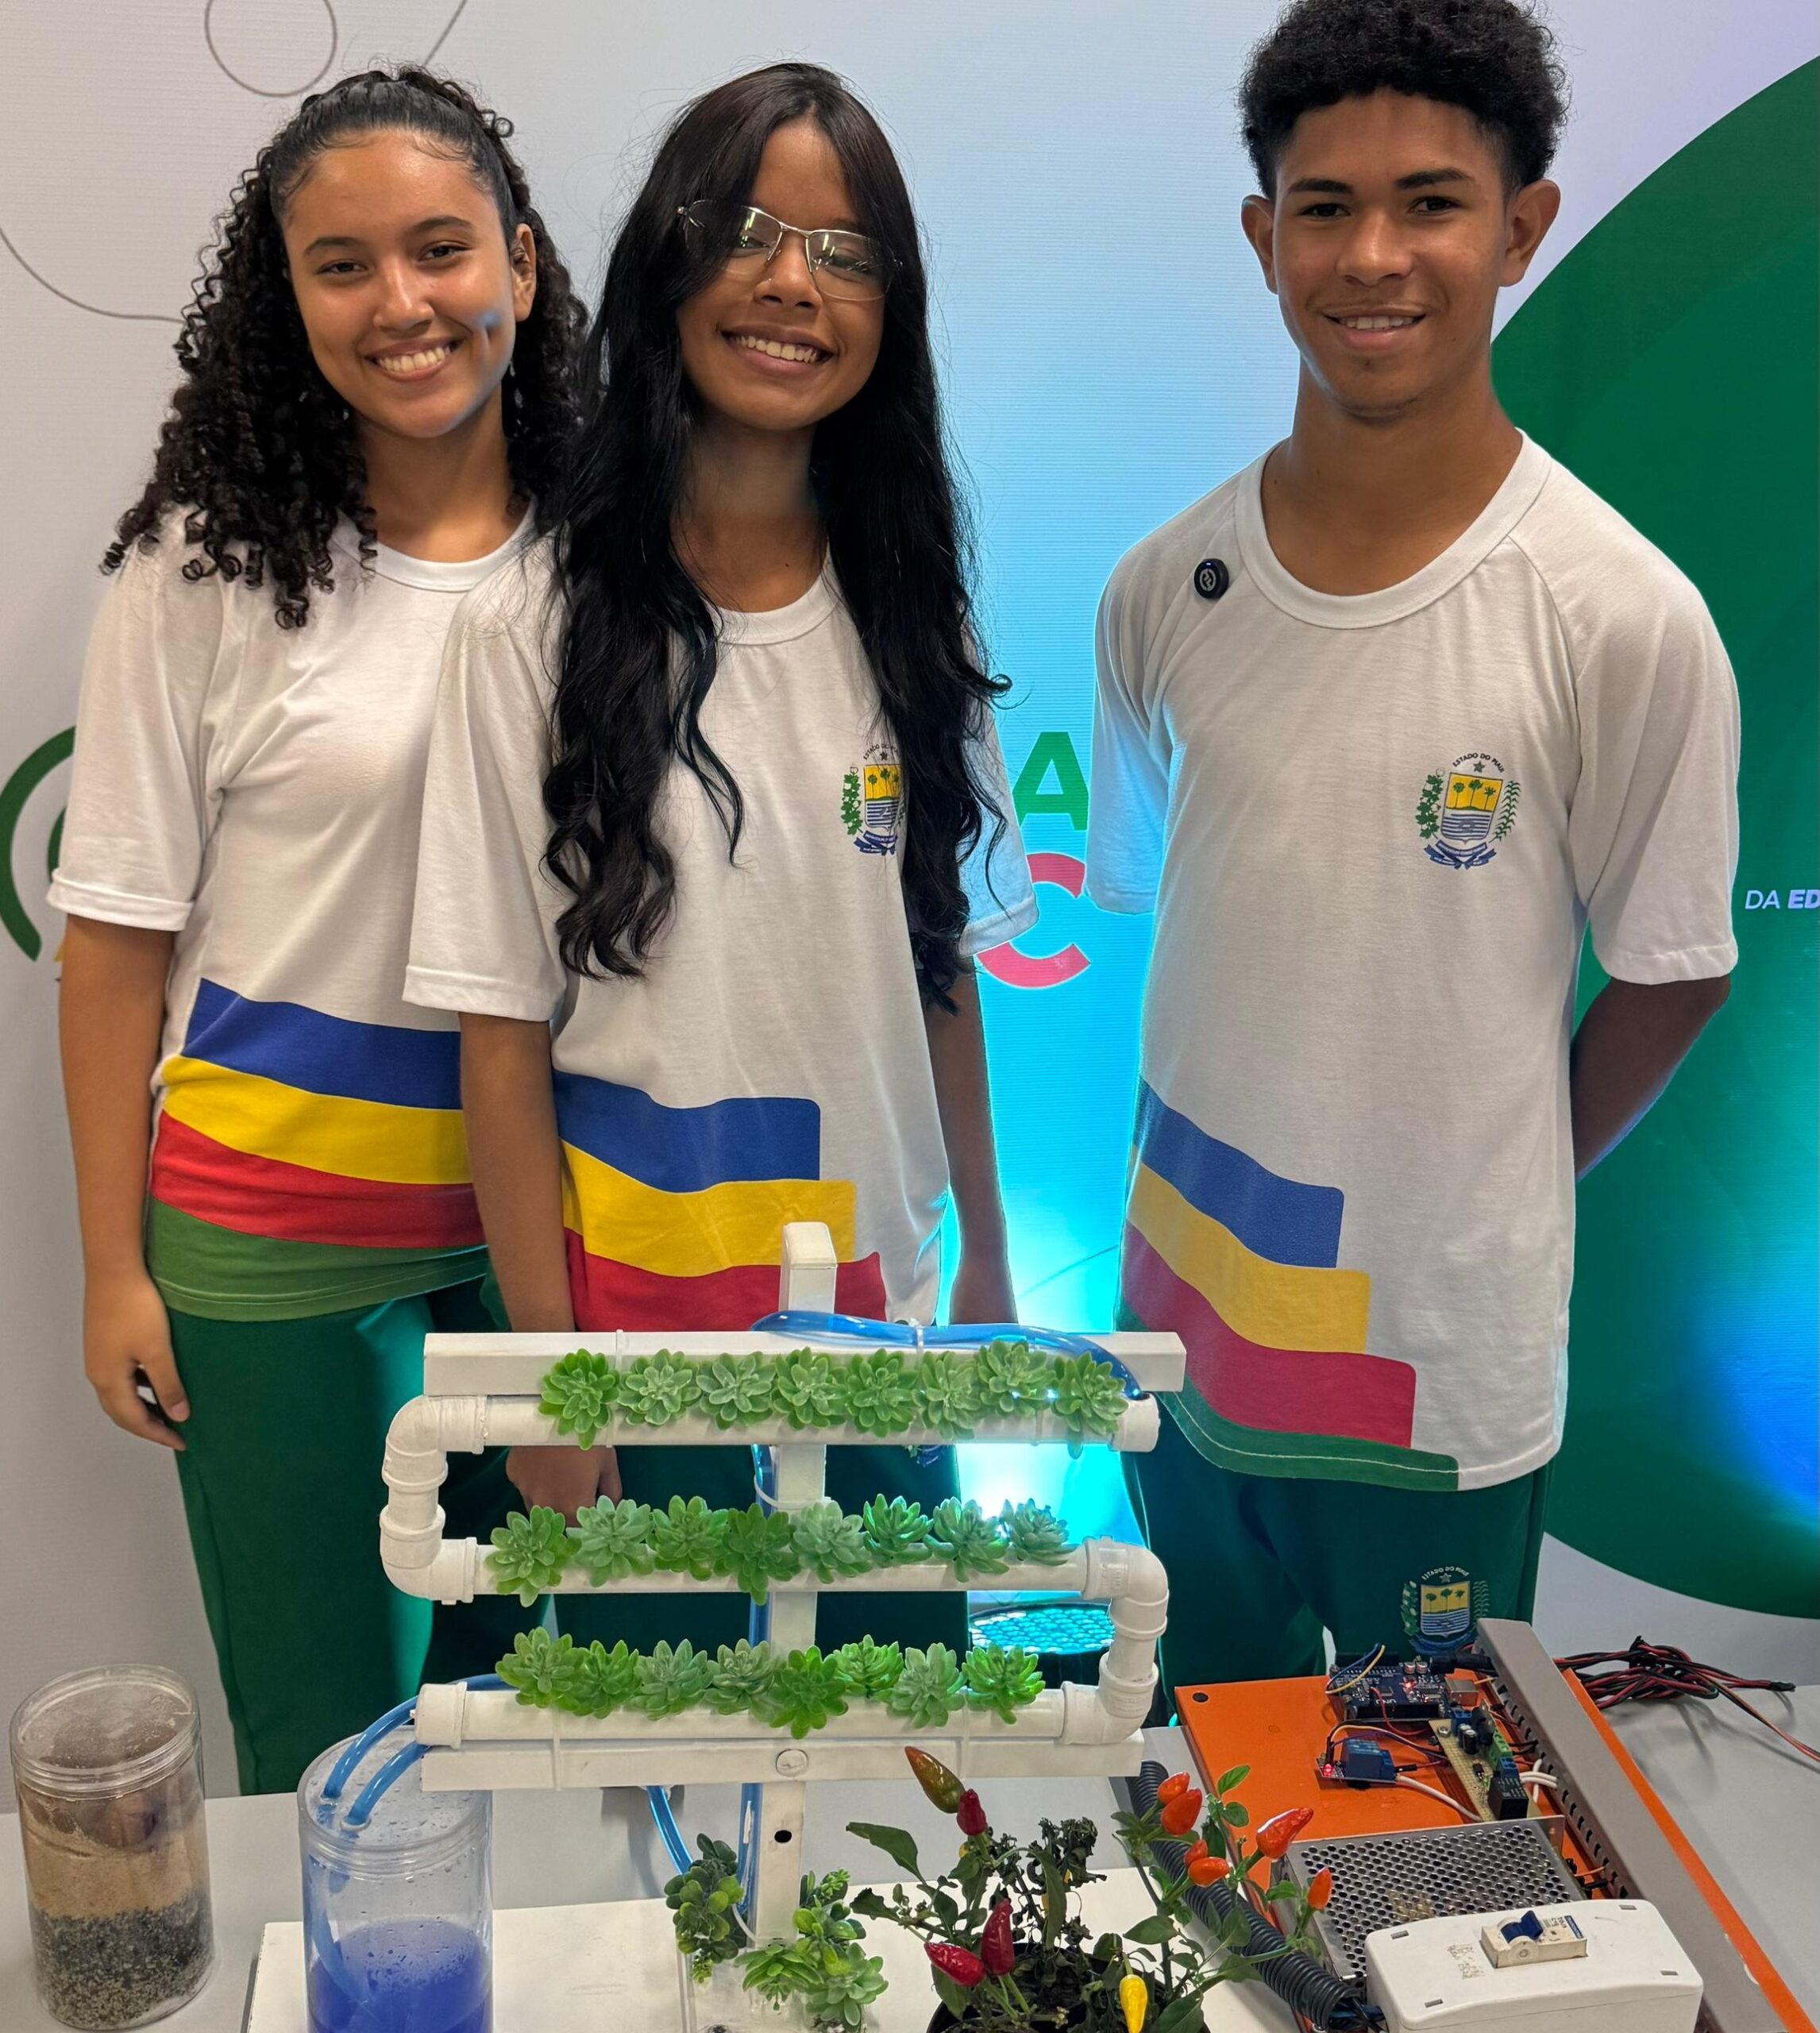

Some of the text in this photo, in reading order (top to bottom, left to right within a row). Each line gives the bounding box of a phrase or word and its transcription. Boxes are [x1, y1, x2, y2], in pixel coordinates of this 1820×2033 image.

[1452, 752, 1479, 767] ESTADO
[1012, 731, 1089, 831] A
[1745, 889, 1820, 909] DA ED
